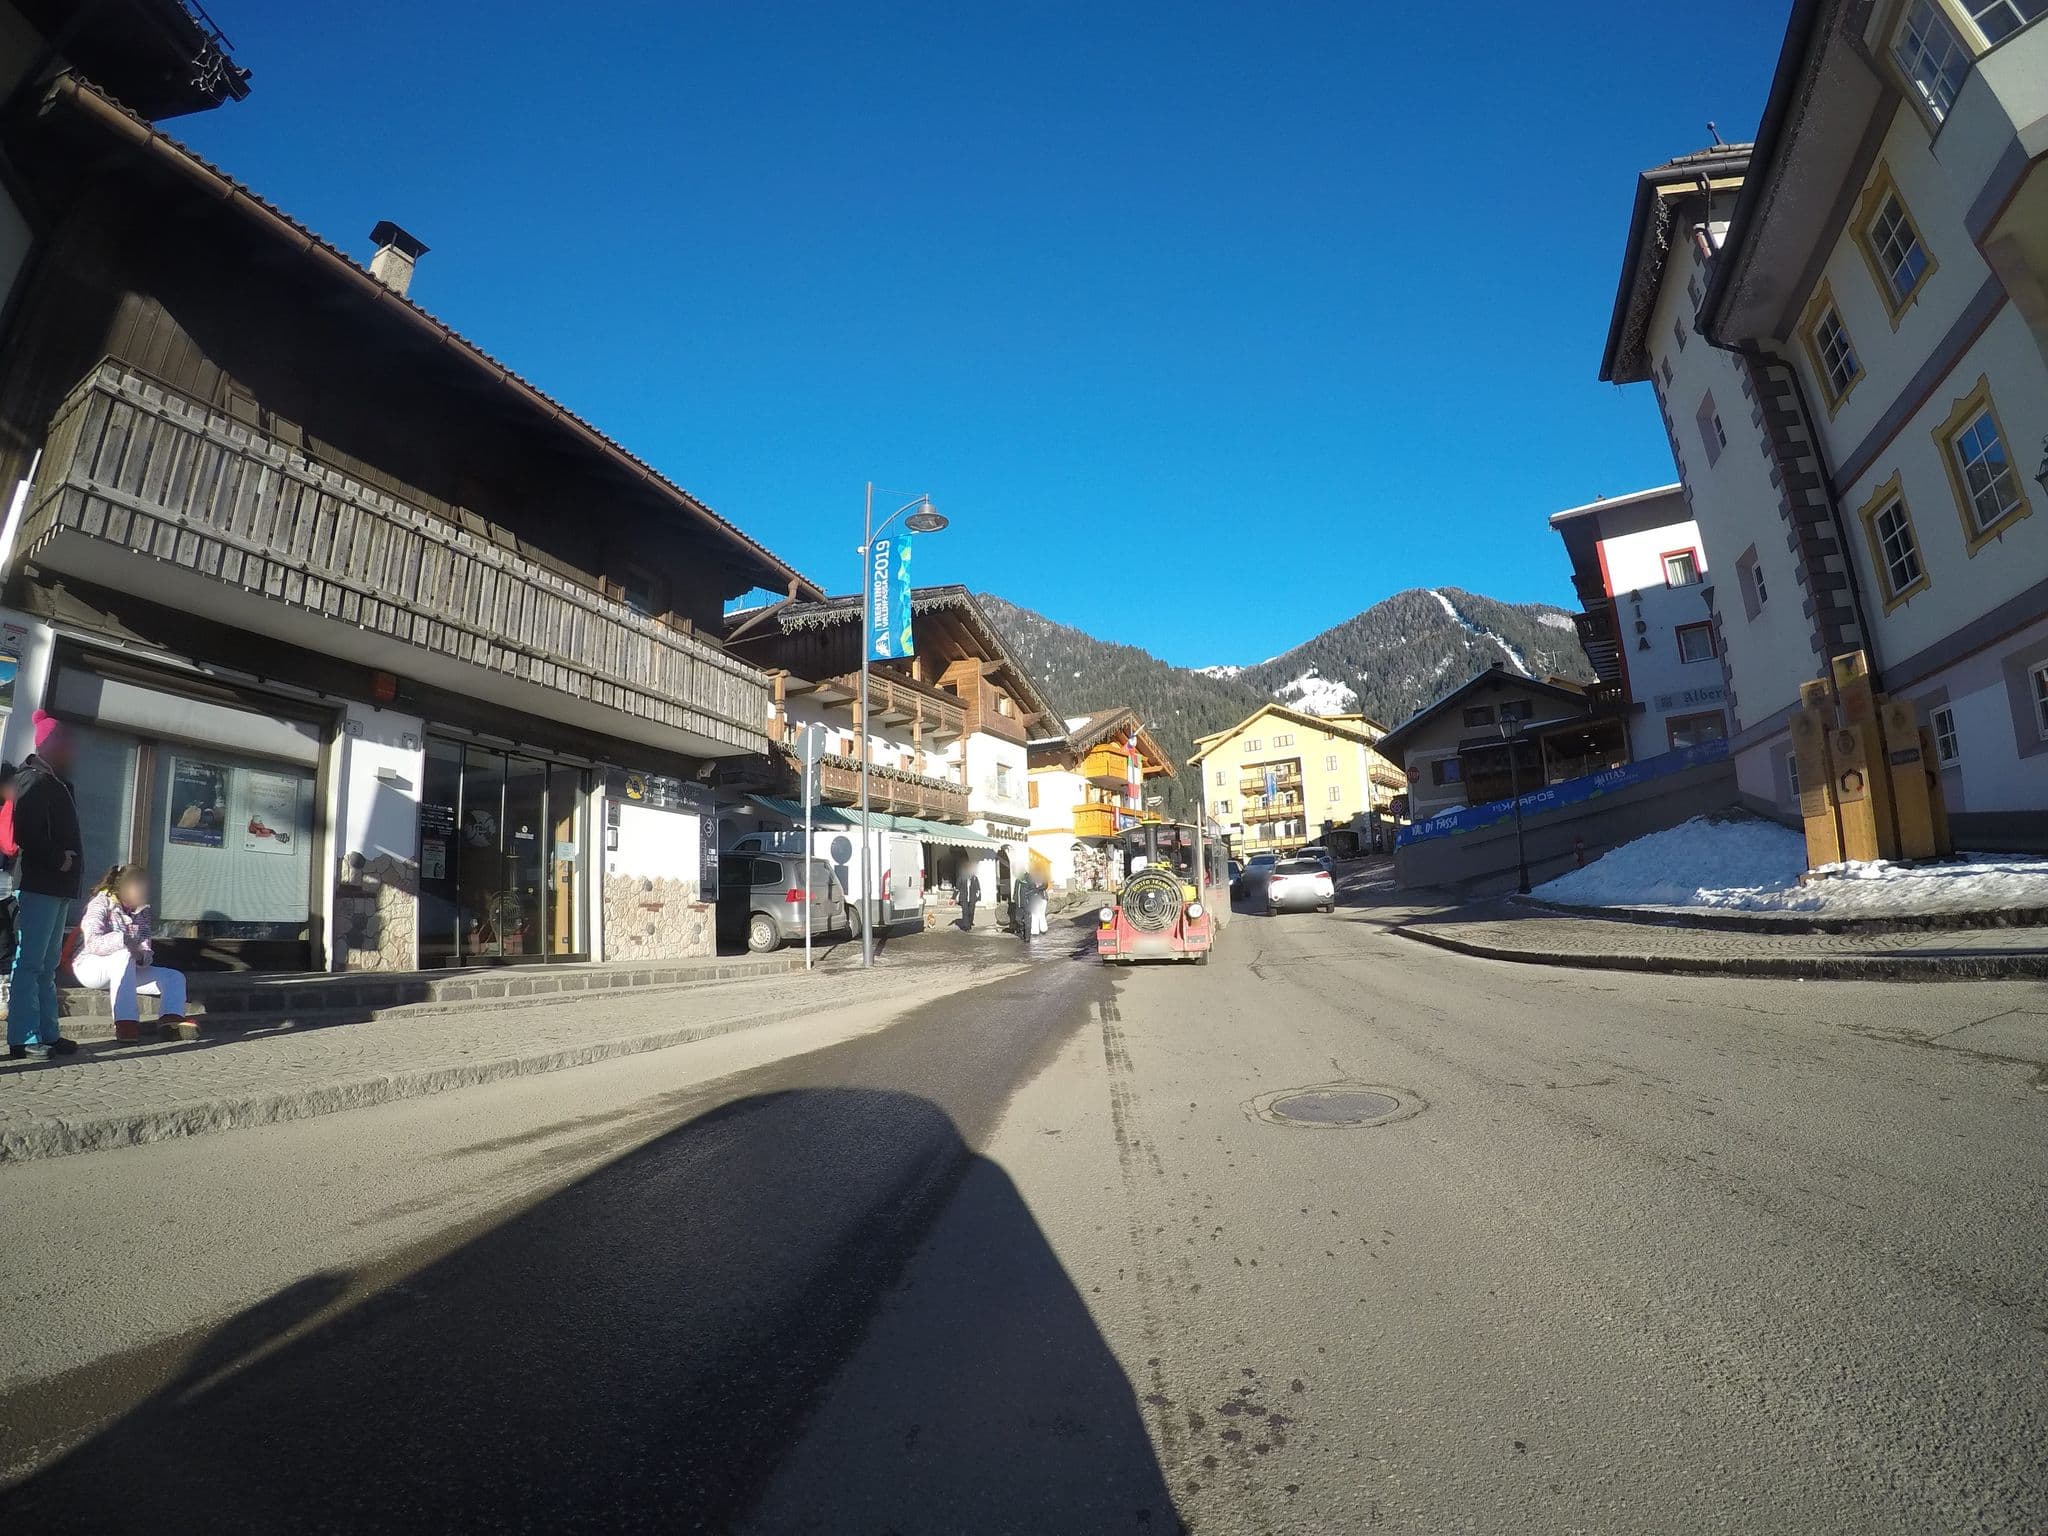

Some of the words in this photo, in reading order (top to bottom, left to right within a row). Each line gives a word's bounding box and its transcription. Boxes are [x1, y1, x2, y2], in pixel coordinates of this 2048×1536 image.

[875, 540, 890, 580] 2019
[874, 581, 882, 629] TRENTINO
[1630, 589, 1651, 650] AIDA
[1411, 824, 1424, 836] VAL
[1436, 816, 1458, 830] FASSA
